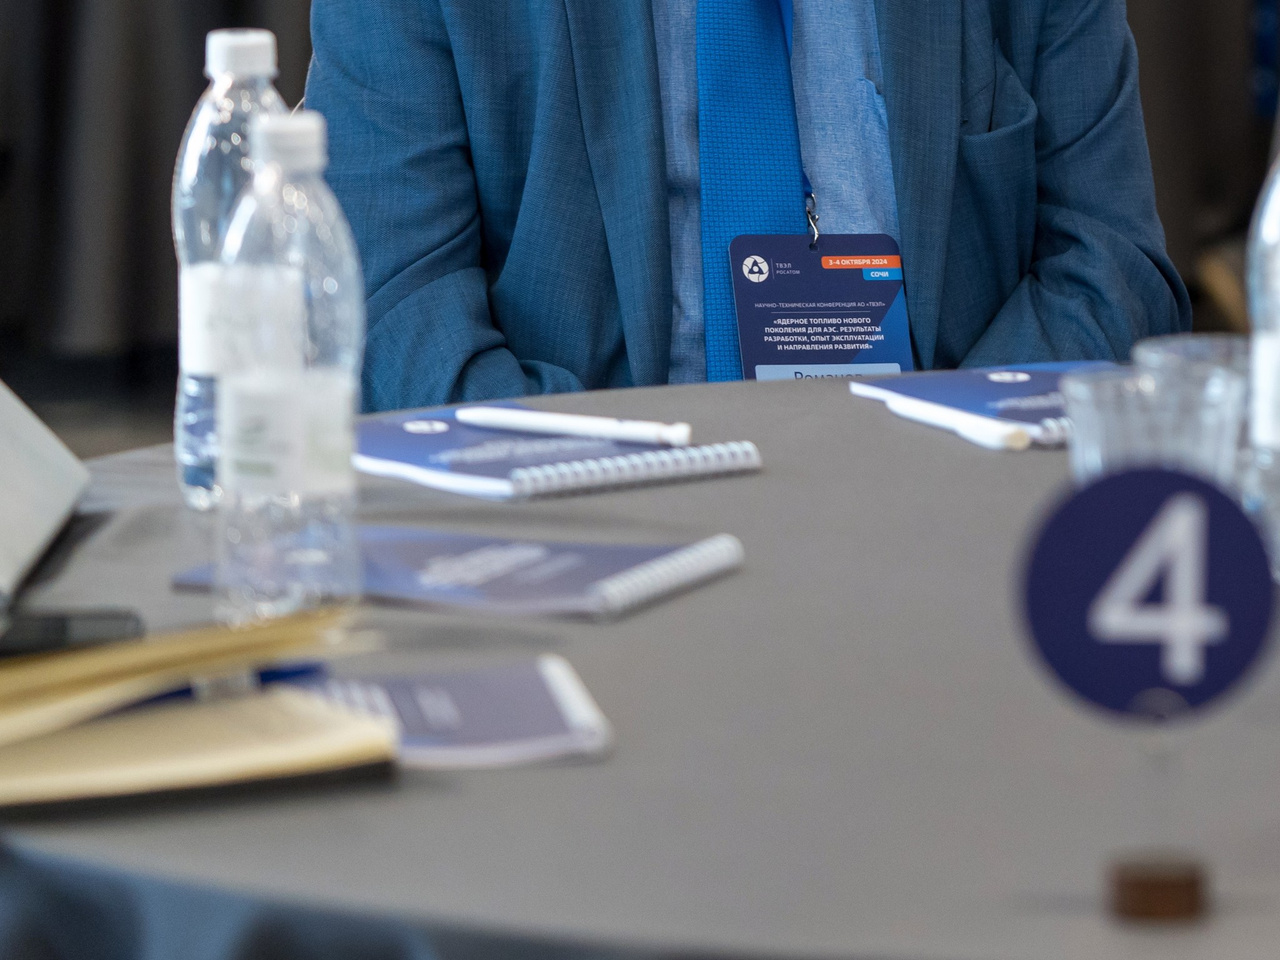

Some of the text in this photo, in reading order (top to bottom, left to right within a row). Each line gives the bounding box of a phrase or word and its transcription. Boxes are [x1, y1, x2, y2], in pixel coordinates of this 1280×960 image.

[764, 335, 810, 343] РАЗРАБОТКИ,
[831, 334, 884, 342] ЭКСПЛУАТАЦИИ
[1087, 492, 1230, 684] 4
